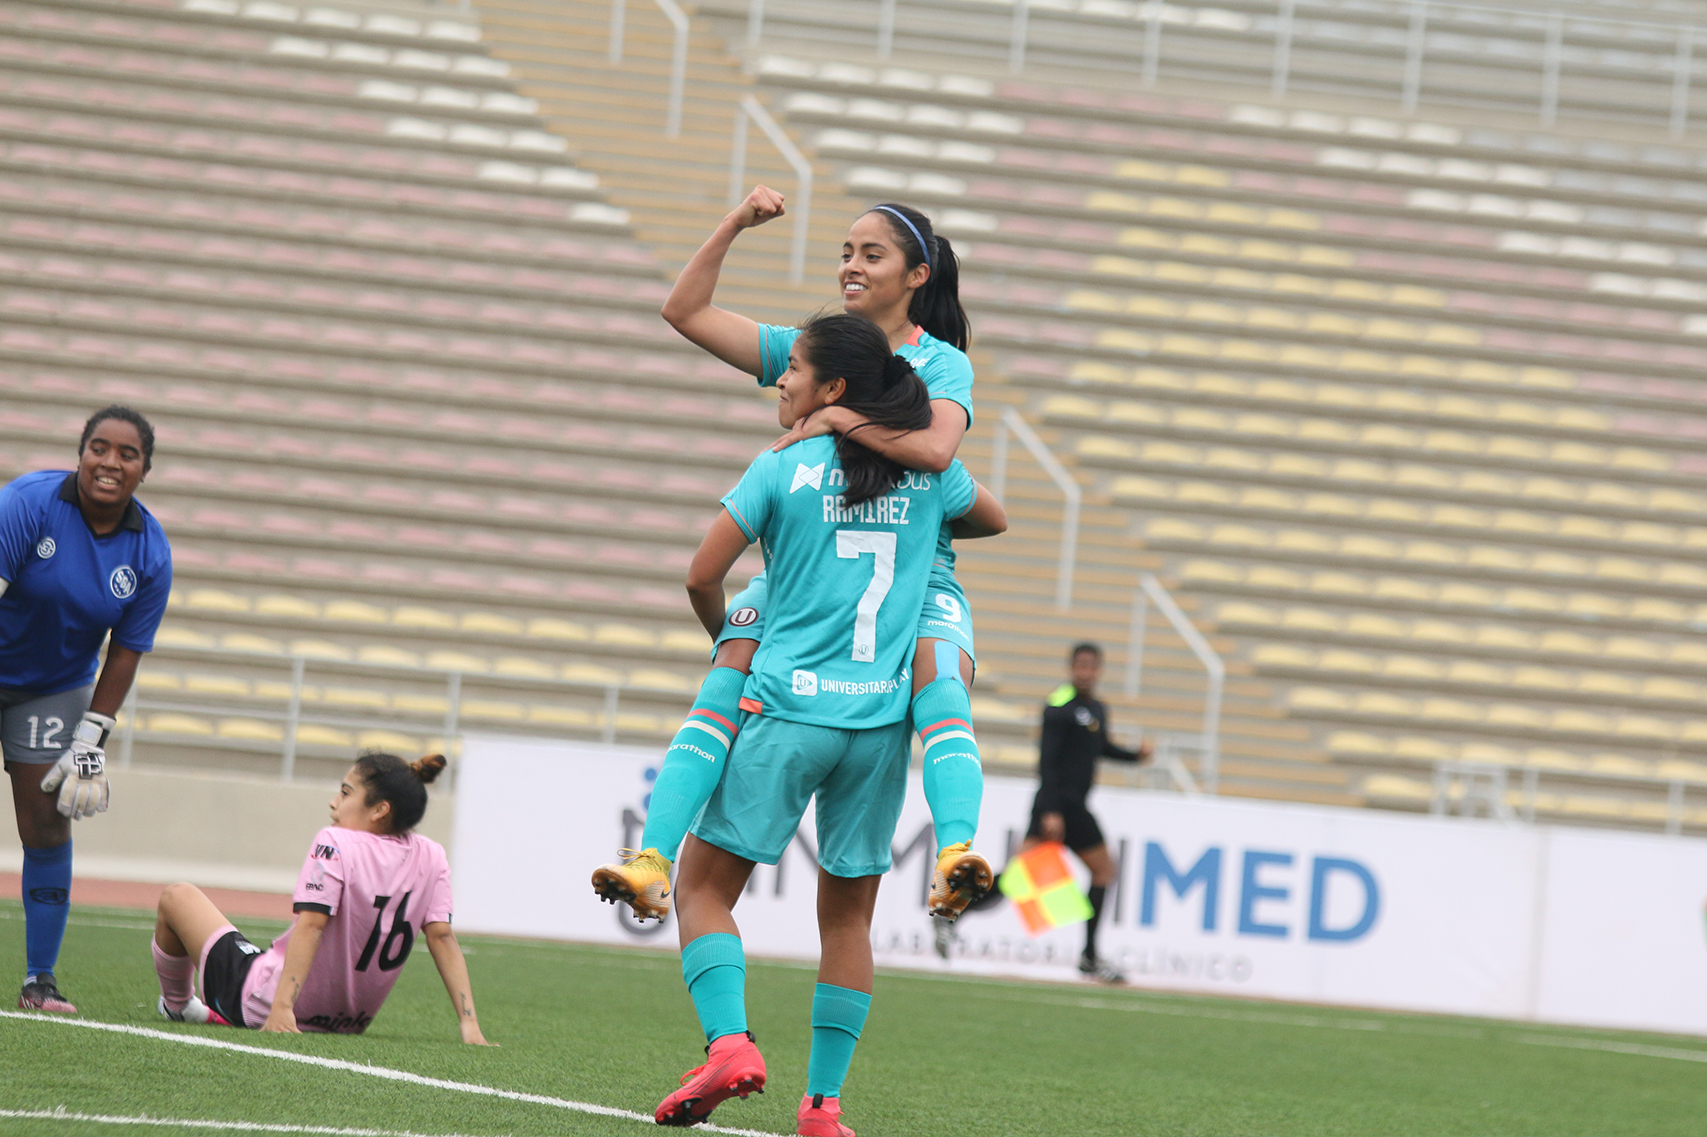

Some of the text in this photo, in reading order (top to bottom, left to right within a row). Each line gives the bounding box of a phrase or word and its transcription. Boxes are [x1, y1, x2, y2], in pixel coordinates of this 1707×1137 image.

[822, 494, 910, 525] RAMIREZ
[836, 529, 897, 663] 7
[935, 593, 962, 623] 9
[27, 715, 64, 749] 12
[667, 743, 716, 763] arathon
[354, 890, 414, 973] 16
